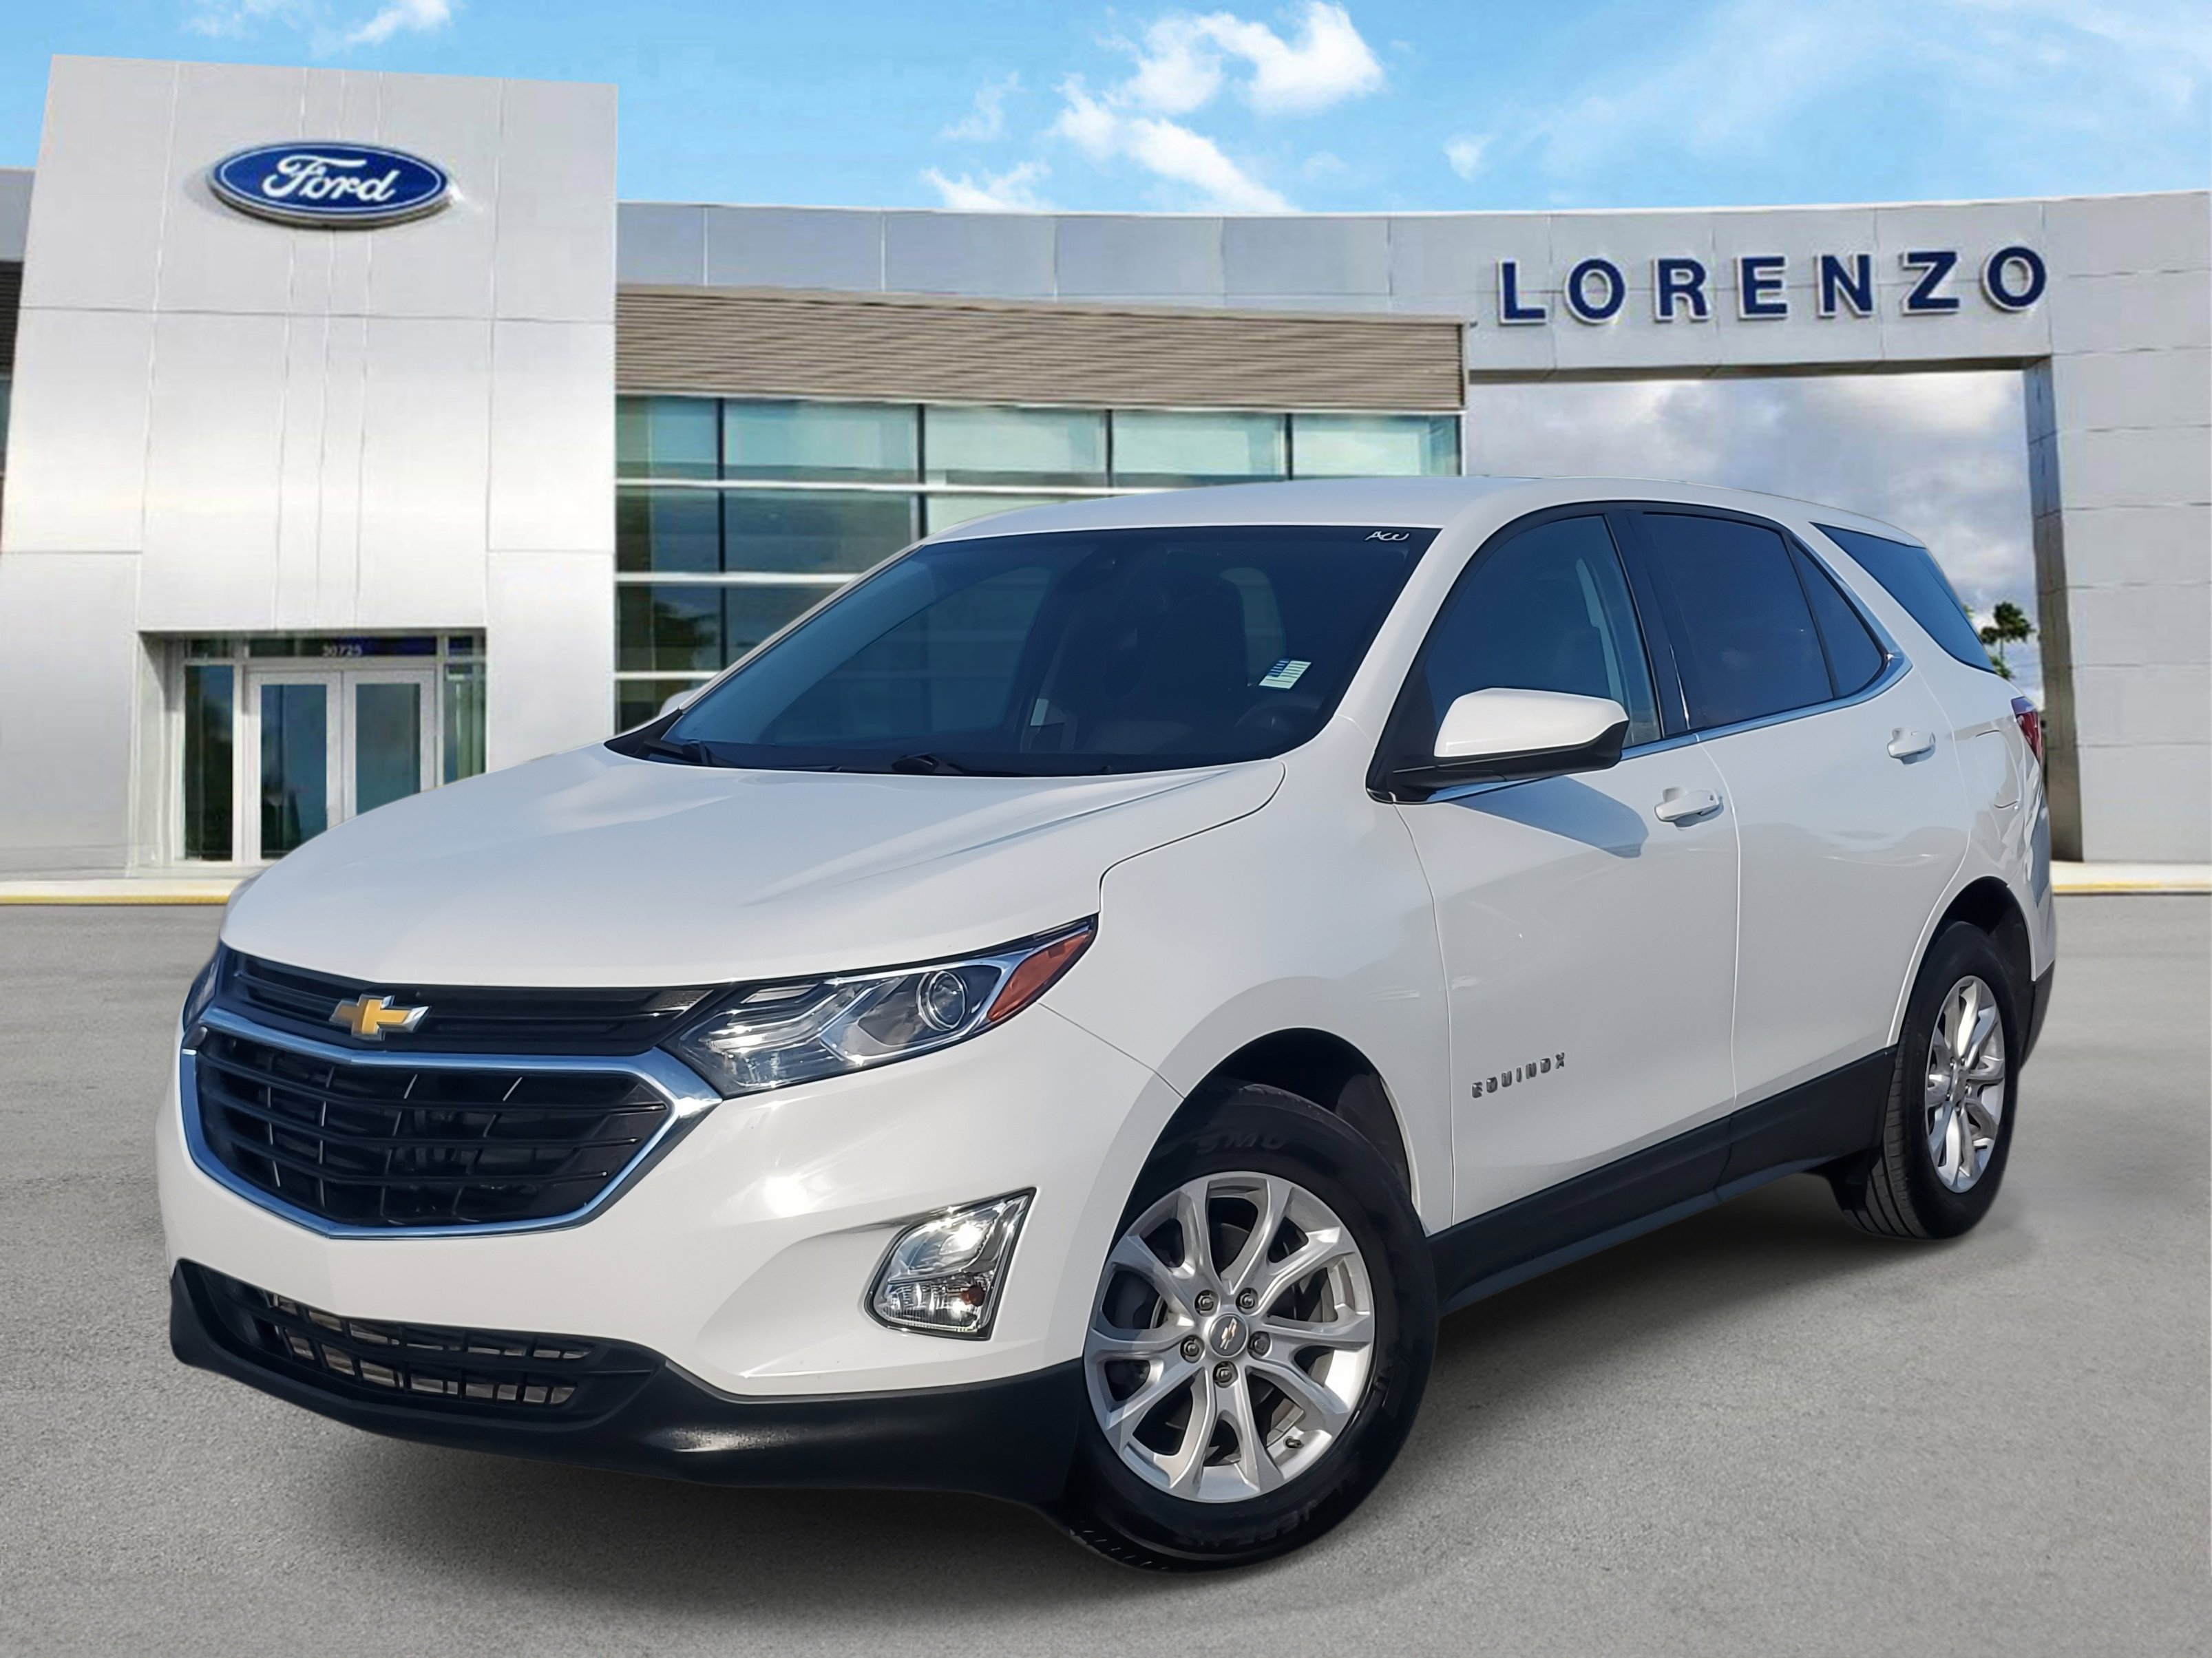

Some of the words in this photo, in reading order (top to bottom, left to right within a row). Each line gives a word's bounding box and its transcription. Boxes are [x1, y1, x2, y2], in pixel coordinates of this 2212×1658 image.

[262, 153, 401, 202] Ford
[1497, 245, 2047, 325] LORENZO
[1471, 1052, 1566, 1098] EQUINOX
